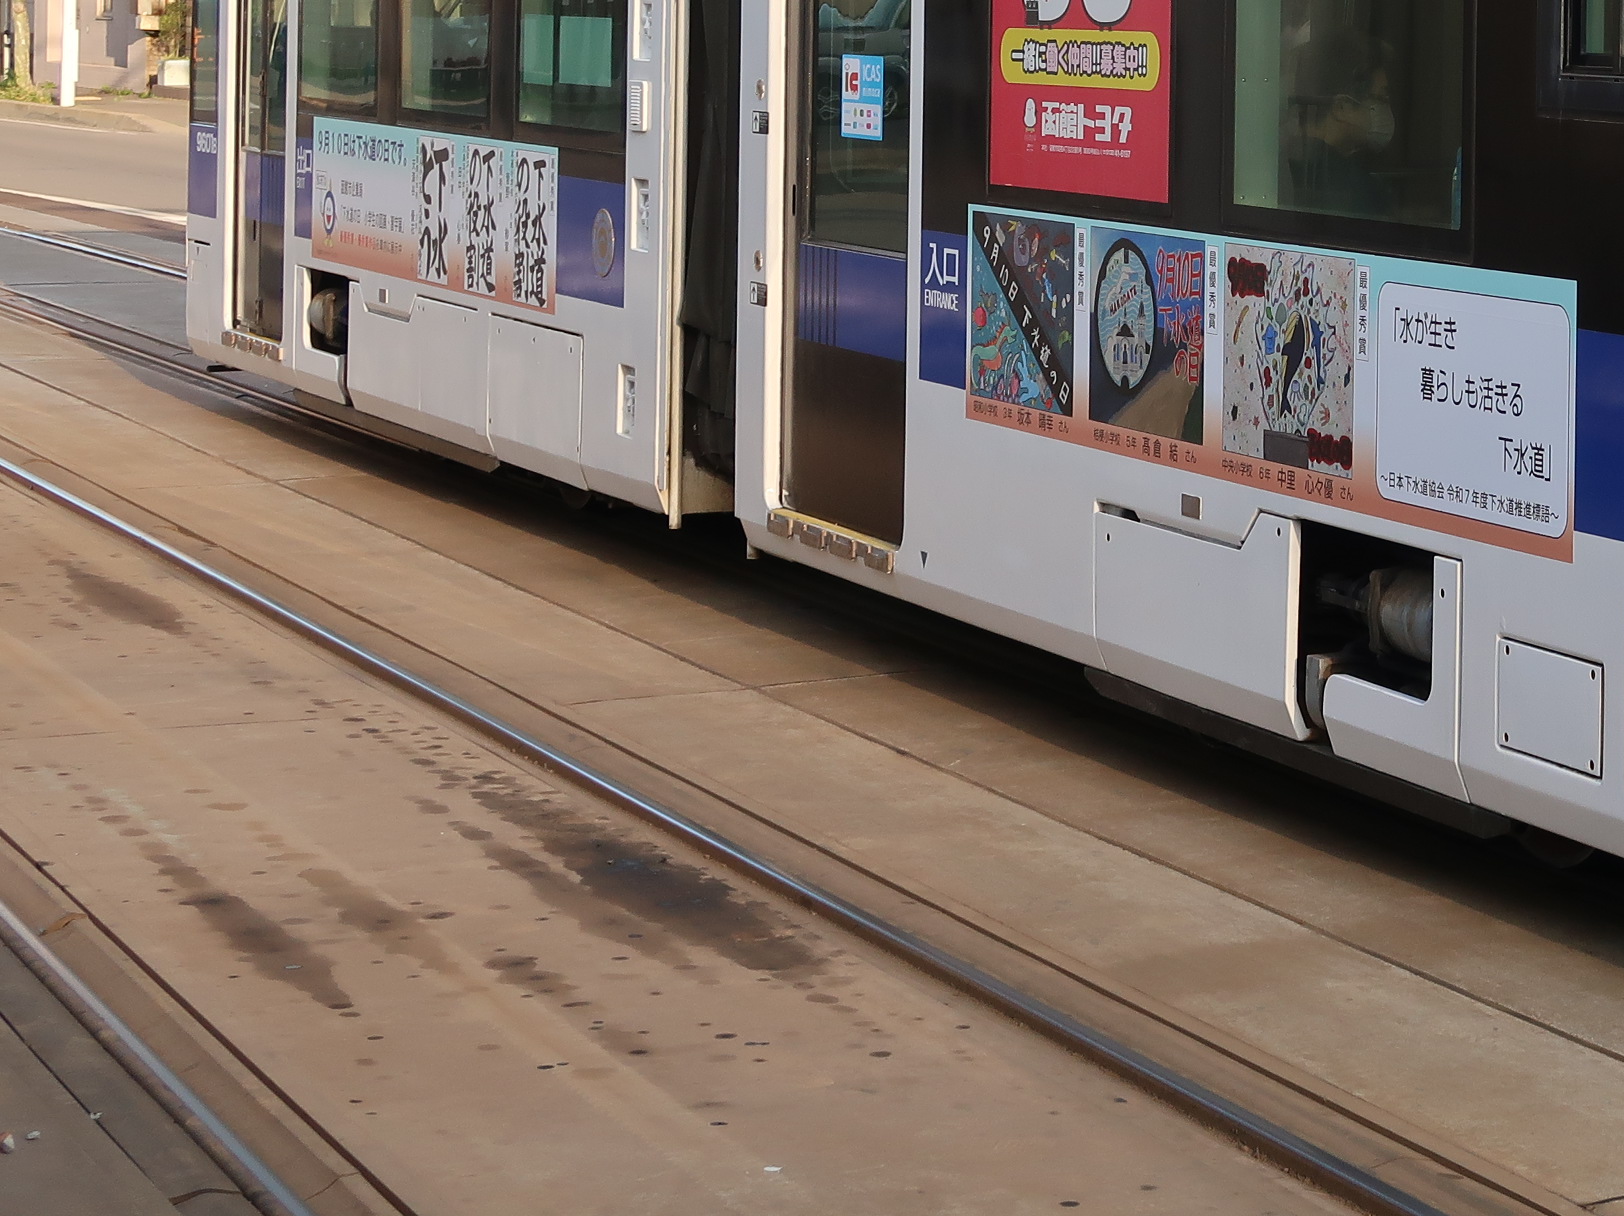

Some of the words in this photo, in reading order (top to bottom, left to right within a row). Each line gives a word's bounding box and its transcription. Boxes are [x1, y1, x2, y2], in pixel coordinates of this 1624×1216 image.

[862, 64, 881, 83] ICAS
[1041, 101, 1133, 144] 函館トヨタ
[296, 145, 312, 173] 出口
[466, 148, 482, 291] の役割
[480, 149, 497, 294] 下水道
[512, 156, 531, 303] の役割
[529, 158, 548, 308] 下水道
[924, 242, 960, 286] 入口
[1155, 246, 1204, 302] 9月10日
[924, 289, 959, 312] ENTRANCE
[1357, 271, 1368, 357] 最優秀賞
[1392, 306, 1458, 351] 「水が生き
[1420, 366, 1524, 417] 暮らしも活きる
[1058, 420, 1070, 434] さん
[1126, 435, 1137, 449] 5年
[1184, 449, 1197, 464] さん
[1221, 457, 1253, 479] 中央小学校
[1258, 466, 1271, 482] 6年
[1276, 467, 1296, 491] 中里
[1304, 474, 1334, 500] 心々優
[1340, 485, 1354, 501] さん
[1498, 436, 1552, 482] 下水道」
